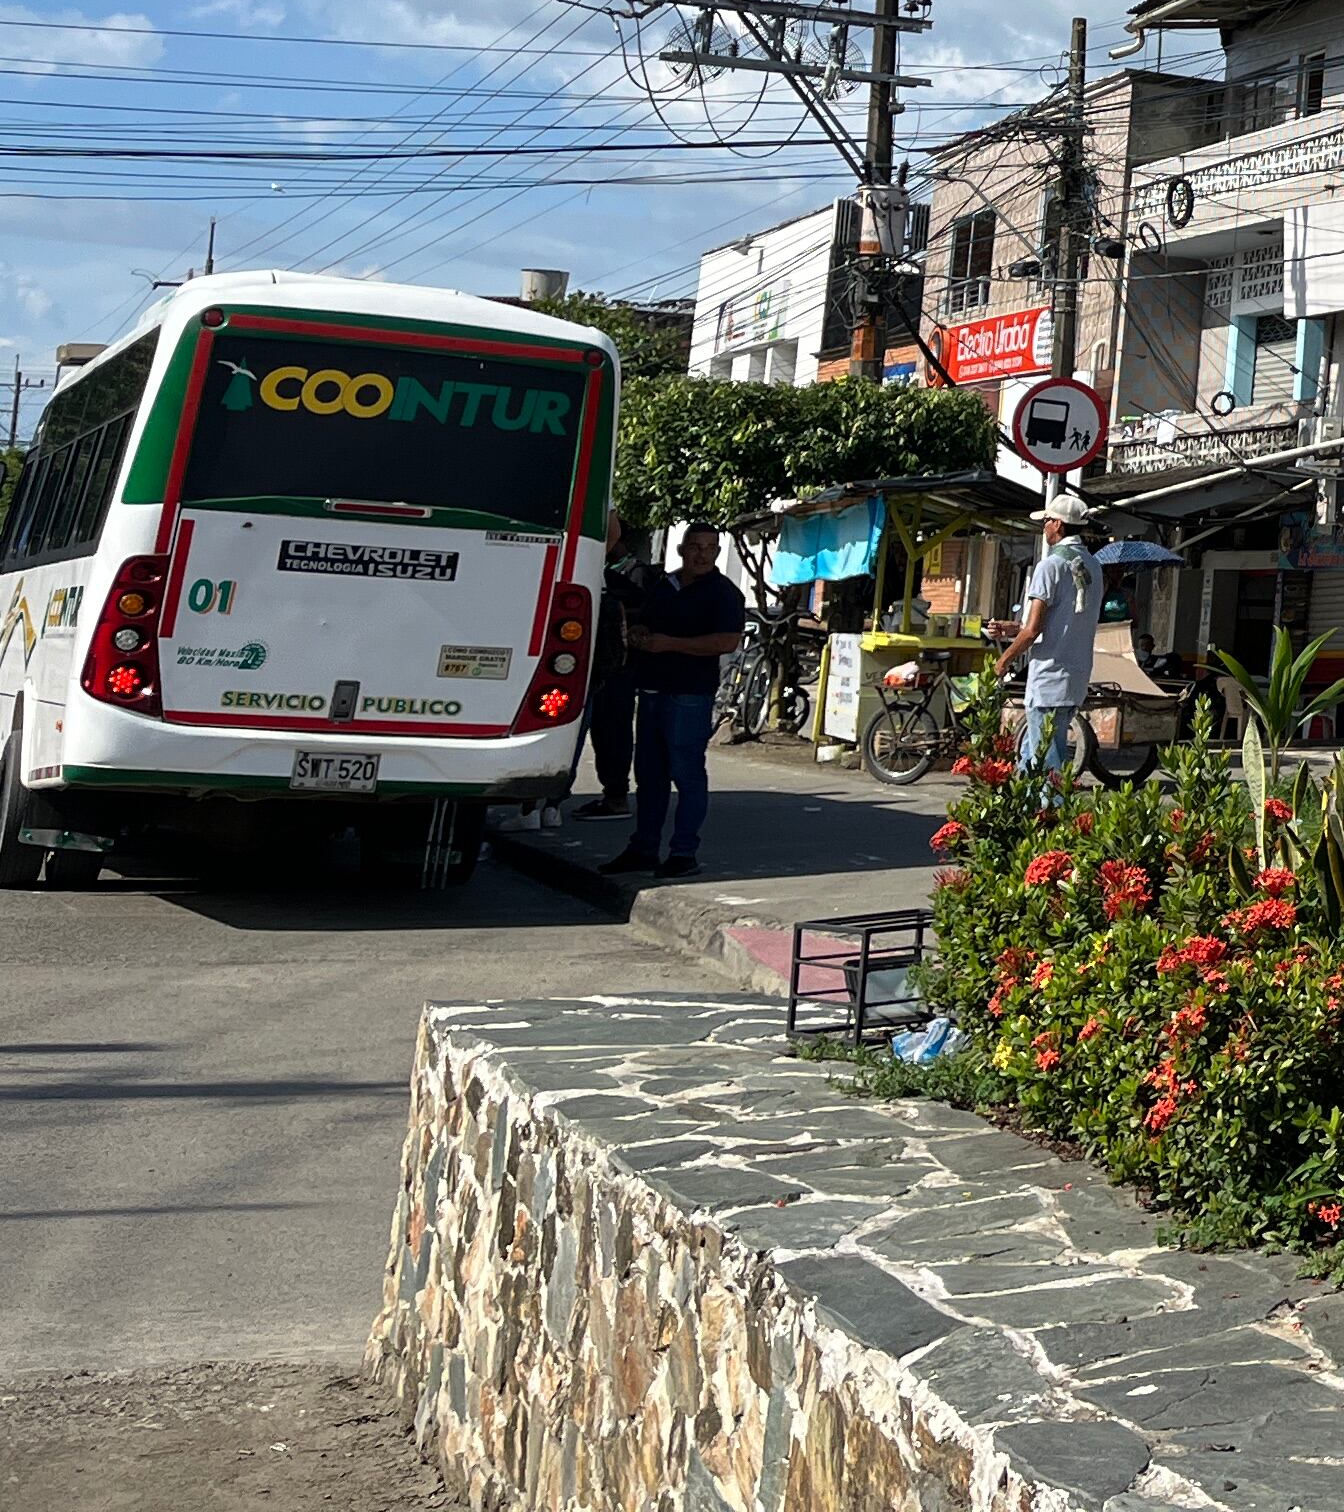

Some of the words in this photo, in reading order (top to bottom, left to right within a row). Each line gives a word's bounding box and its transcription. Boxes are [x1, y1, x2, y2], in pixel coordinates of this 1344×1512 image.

[957, 325, 994, 362] Electro
[260, 366, 571, 435] COOINTUR
[288, 541, 454, 566] CHEVROLET
[285, 558, 364, 574] TECNOLOGIA
[368, 562, 452, 580] ISUZU
[188, 578, 237, 616] 01
[221, 691, 326, 711] SERVICIO
[361, 696, 463, 716] PUBLICO
[297, 757, 334, 780] SWT
[338, 759, 375, 782] 520
